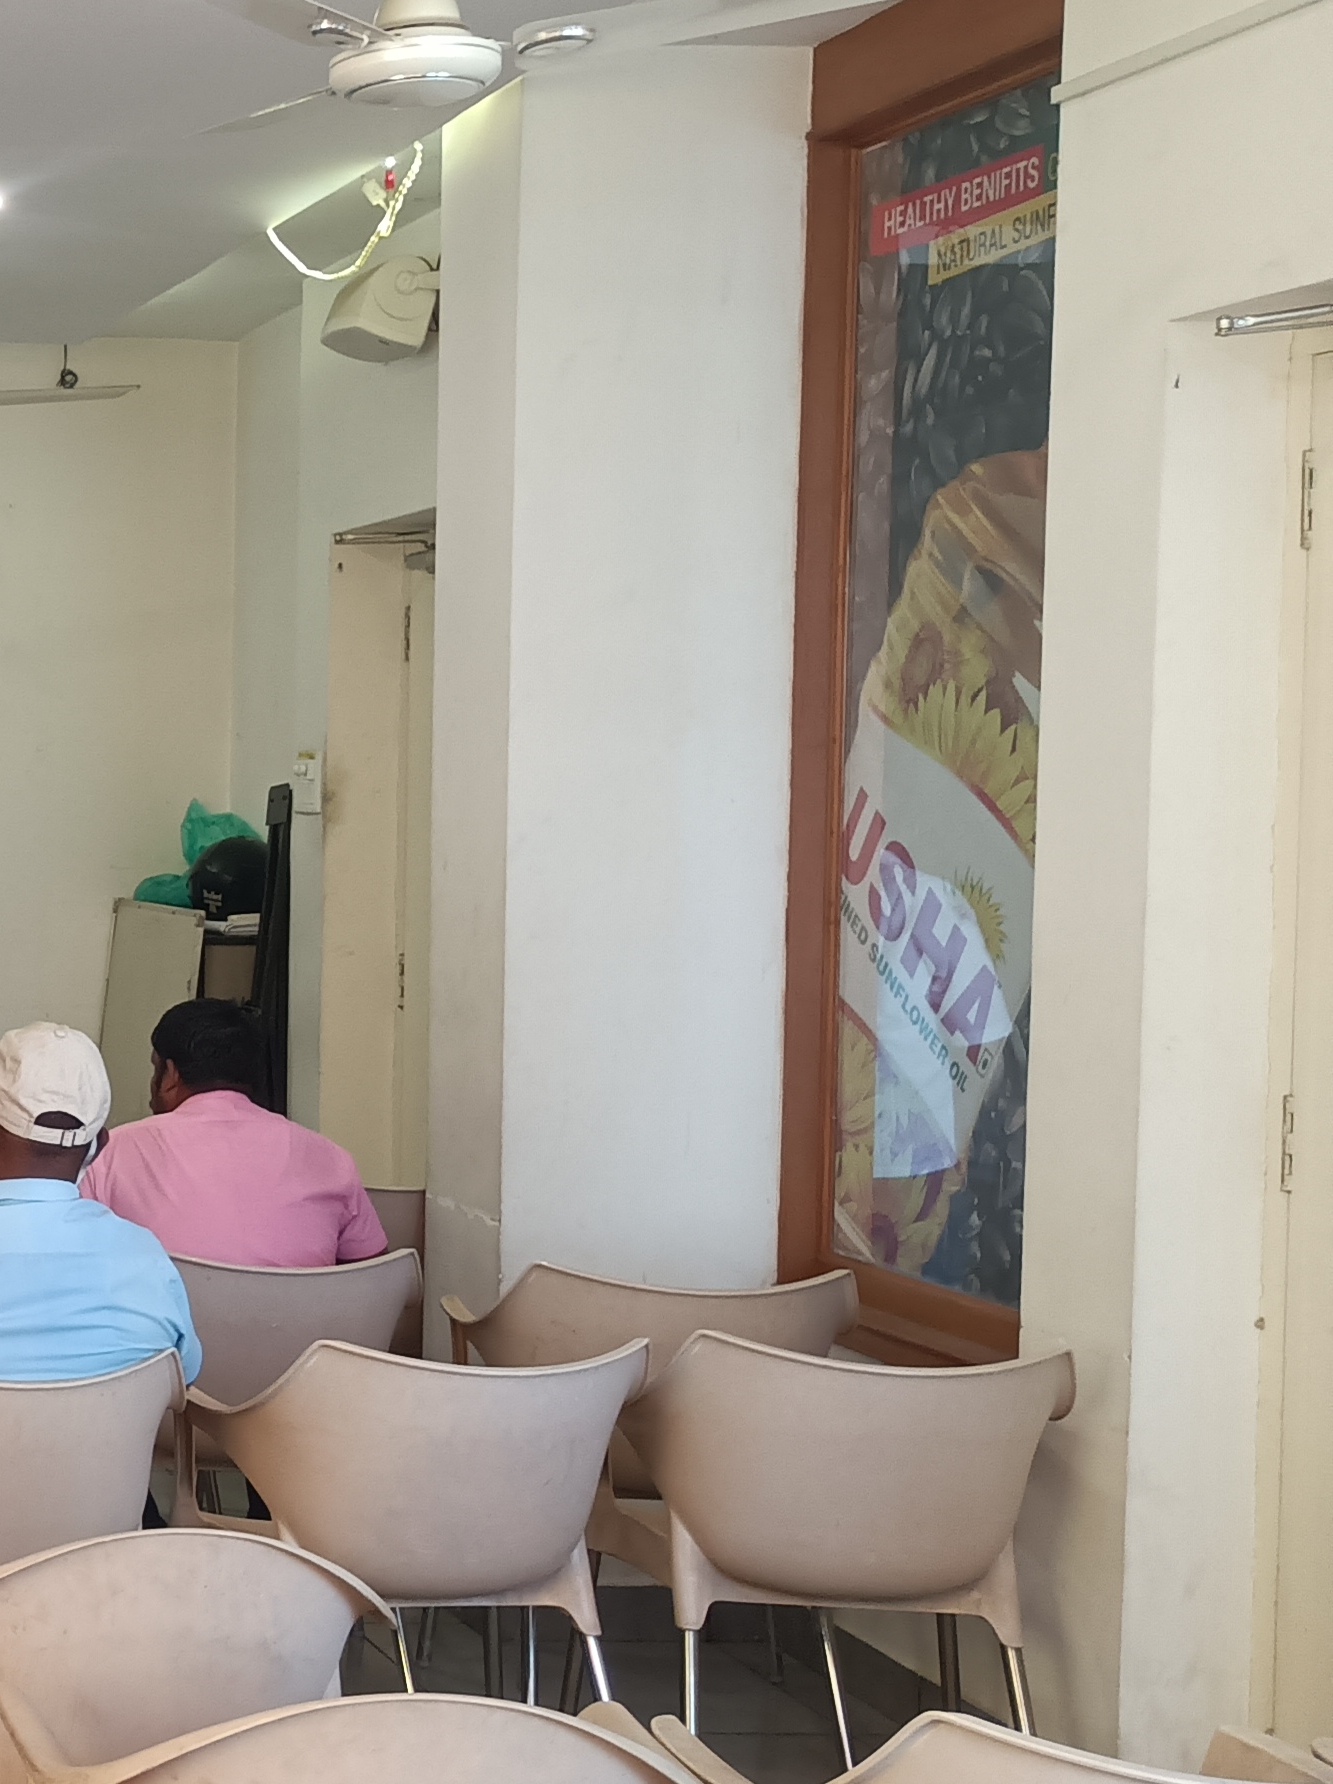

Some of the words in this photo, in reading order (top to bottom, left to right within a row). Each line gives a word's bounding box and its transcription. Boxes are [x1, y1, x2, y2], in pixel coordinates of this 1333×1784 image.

[884, 186, 956, 238] HEALTHY
[961, 156, 1039, 212] BENIFITS
[936, 224, 1007, 275] NATURAL
[840, 885, 869, 946] INED
[868, 942, 949, 1066] SUNFLOWER
[949, 1061, 968, 1093] OIL
[842, 787, 997, 1066] USHA
